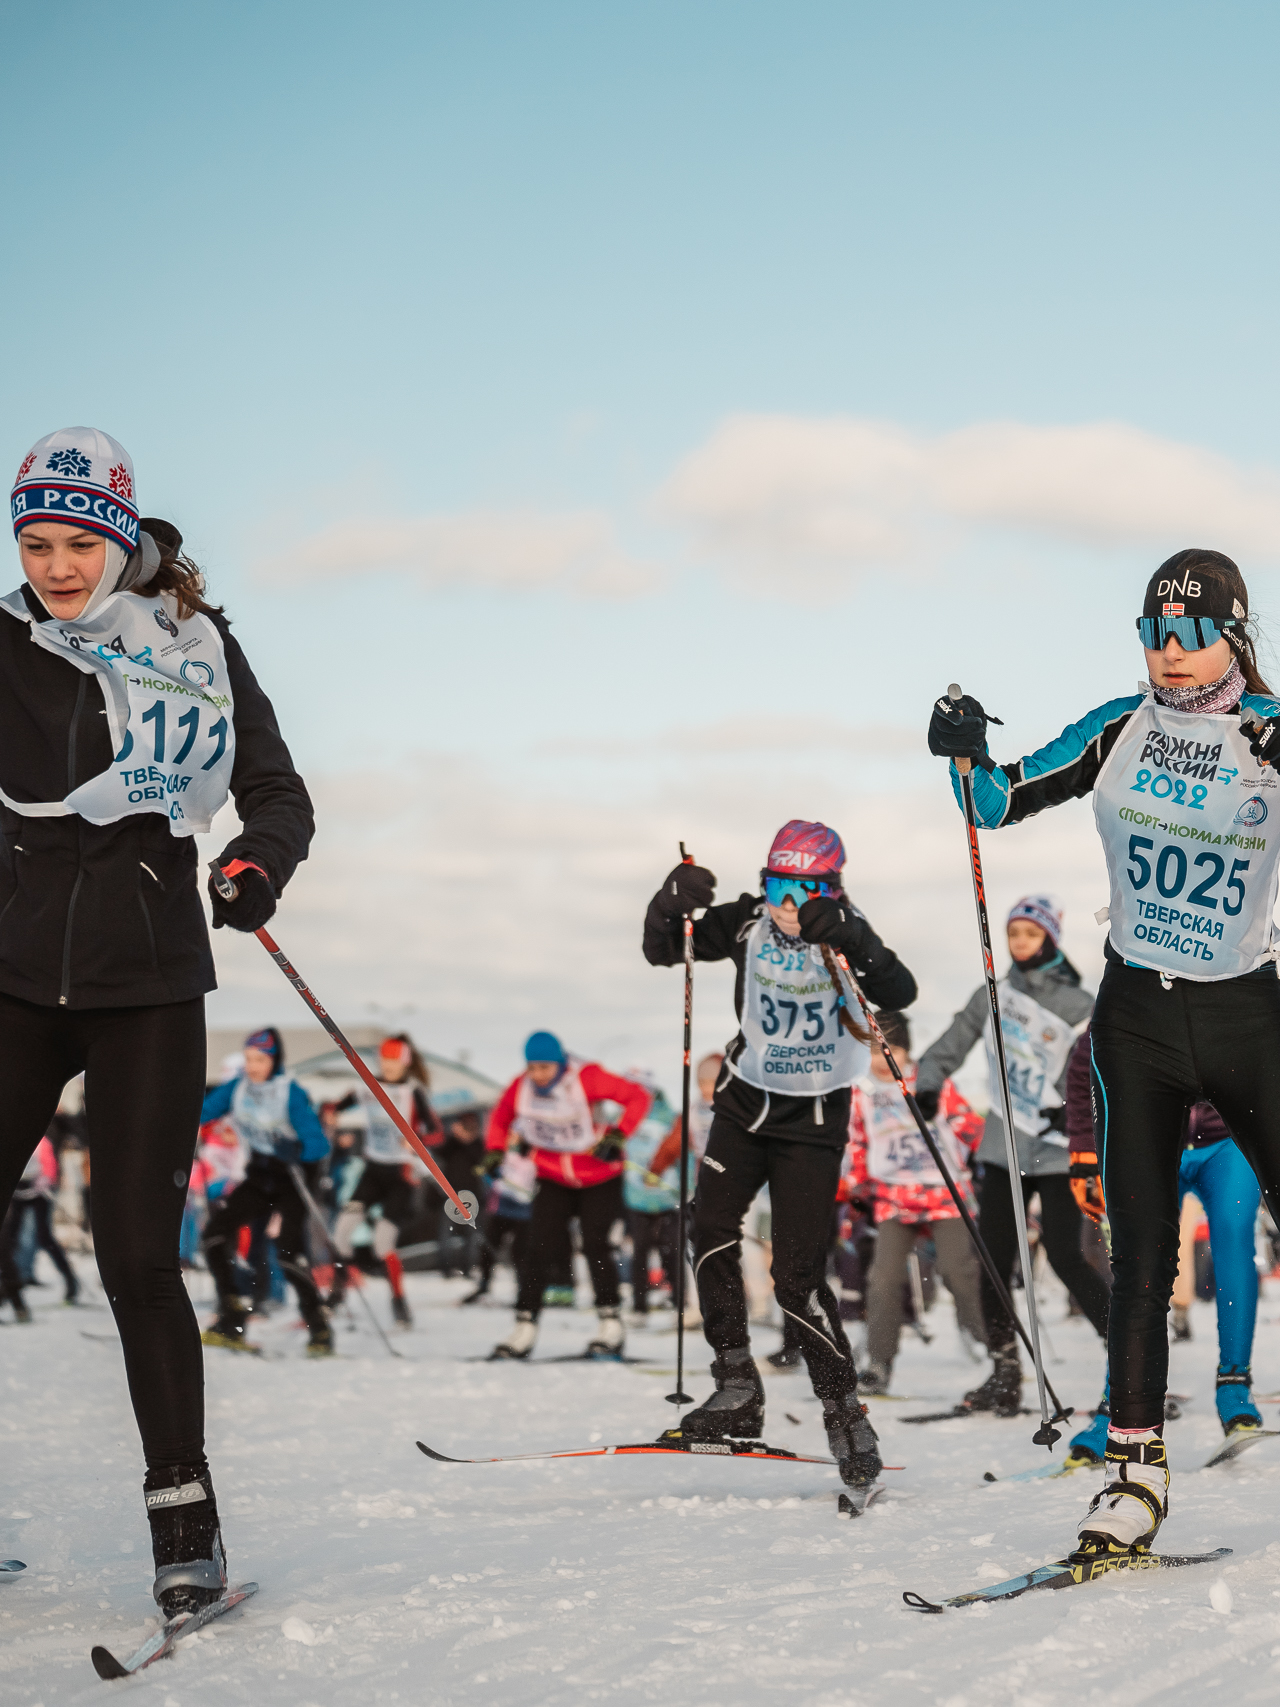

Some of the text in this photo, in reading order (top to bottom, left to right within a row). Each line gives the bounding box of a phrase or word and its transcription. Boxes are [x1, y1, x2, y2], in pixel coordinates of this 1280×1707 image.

[43, 489, 138, 539] РОССИИ
[1157, 569, 1202, 602] DNB
[1139, 743, 1218, 782] РОССИИ
[1145, 730, 1224, 763] ЛЫЖНЯ
[1129, 769, 1209, 811] 2022
[1118, 806, 1267, 852] СПОРТ НОРМА ЖИЗНИ
[1126, 833, 1251, 917] 5025
[1136, 898, 1225, 941] ТВЕРСКАЯ
[1133, 923, 1214, 962] ОБЛАСТЬ
[760, 993, 845, 1042] 3751
[763, 1059, 833, 1075] ОБЛАСТЬ
[765, 1043, 836, 1059] ТВЕРСКАЯ
[690, 1443, 734, 1456] ROSSIGNOL
